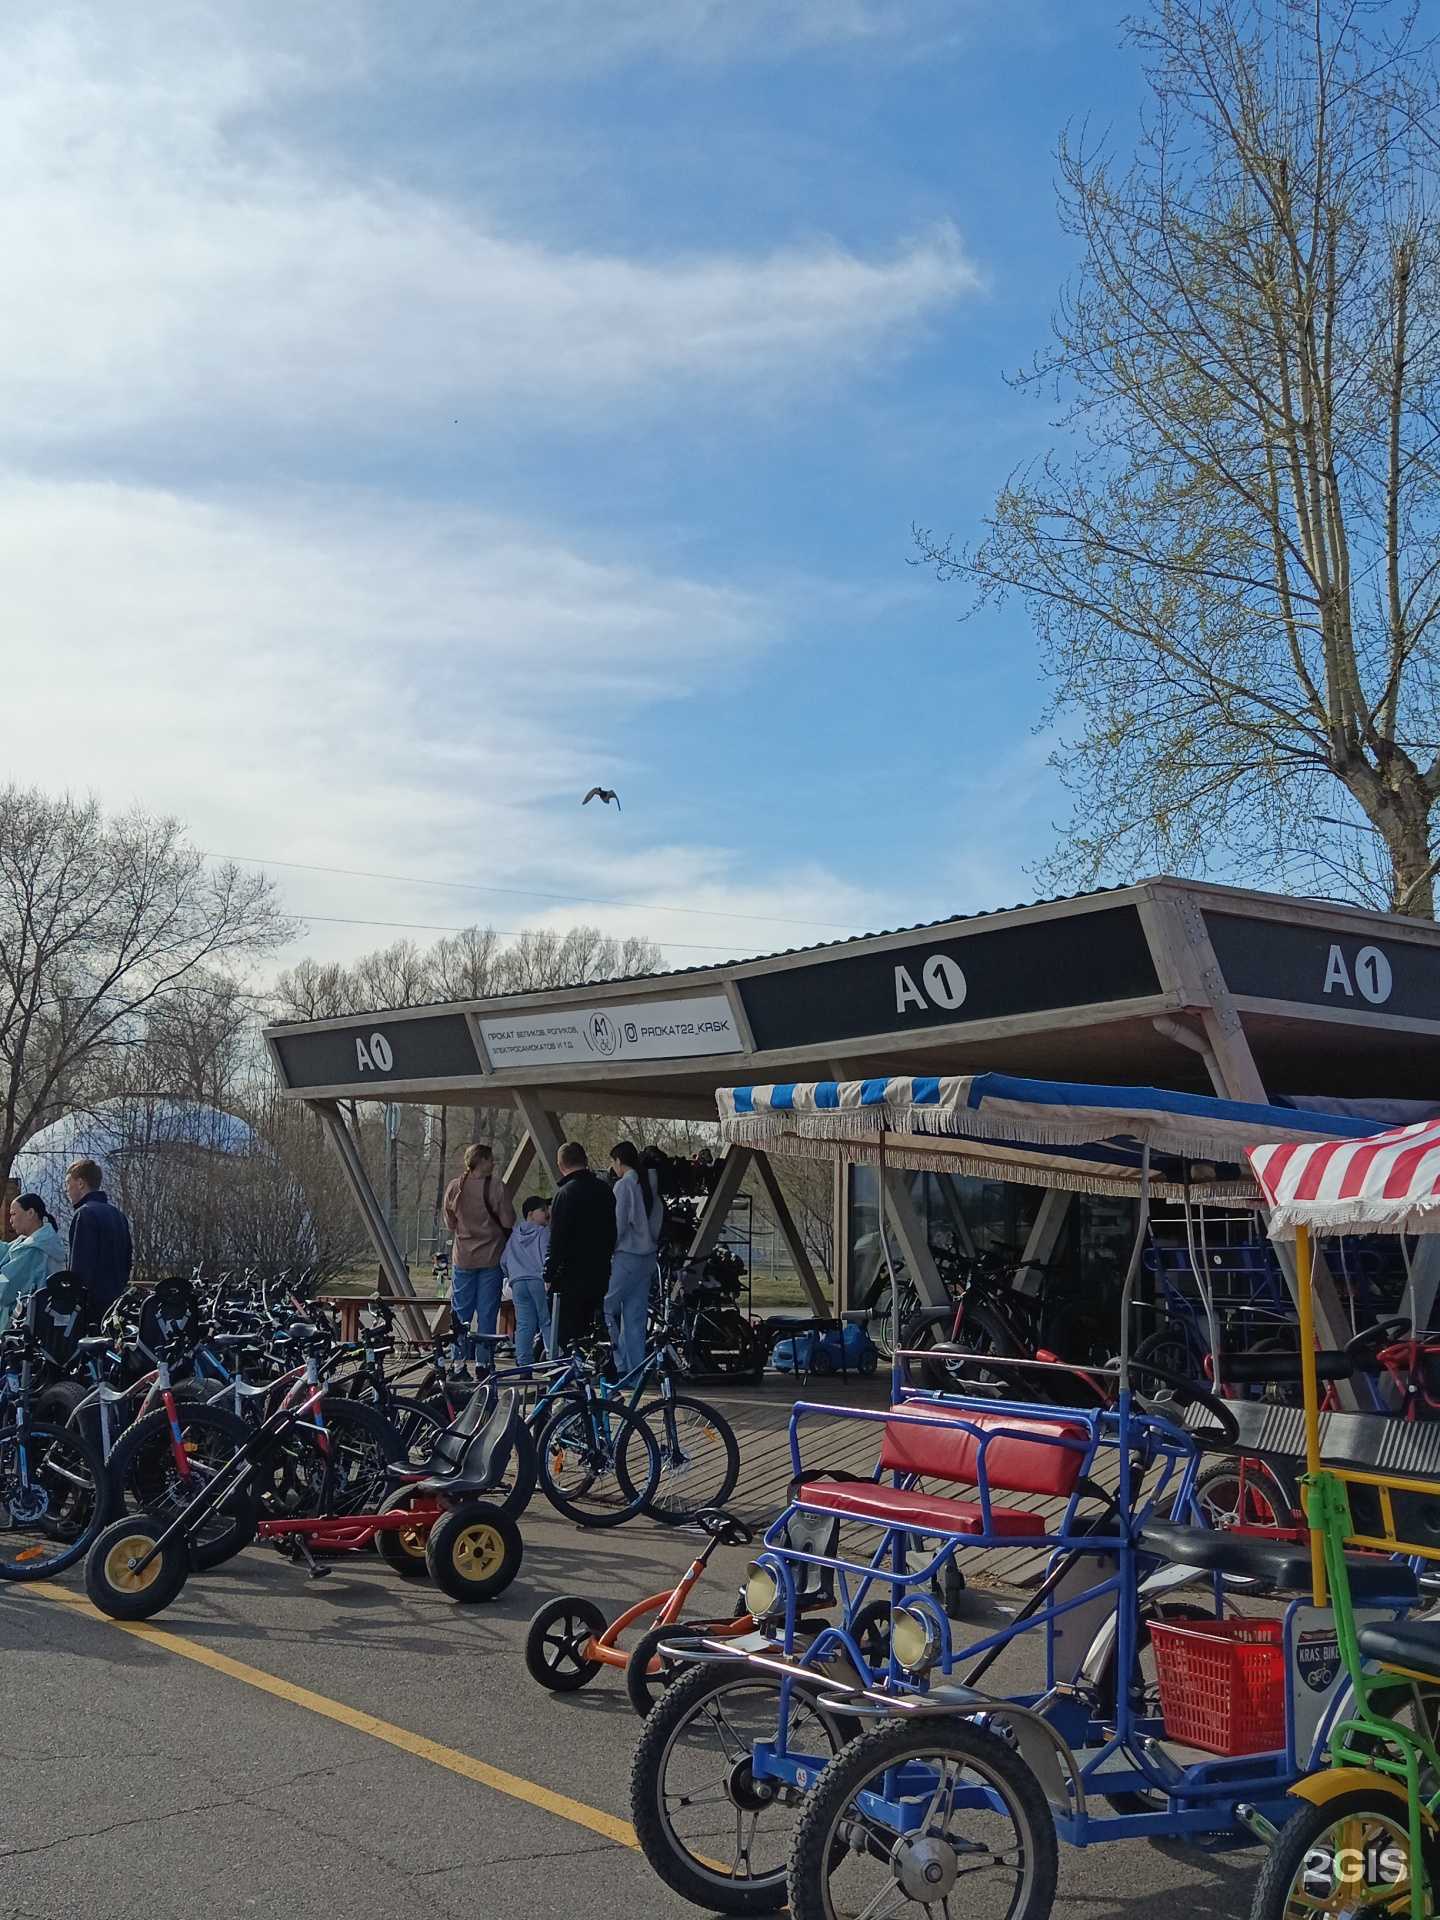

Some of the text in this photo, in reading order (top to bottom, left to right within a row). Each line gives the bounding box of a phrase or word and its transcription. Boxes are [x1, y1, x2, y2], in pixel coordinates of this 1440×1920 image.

[487, 1030, 515, 1041] ПРОКАТ
[593, 1017, 609, 1037] A1
[640, 1019, 731, 1038] PROKAT22_KRSK
